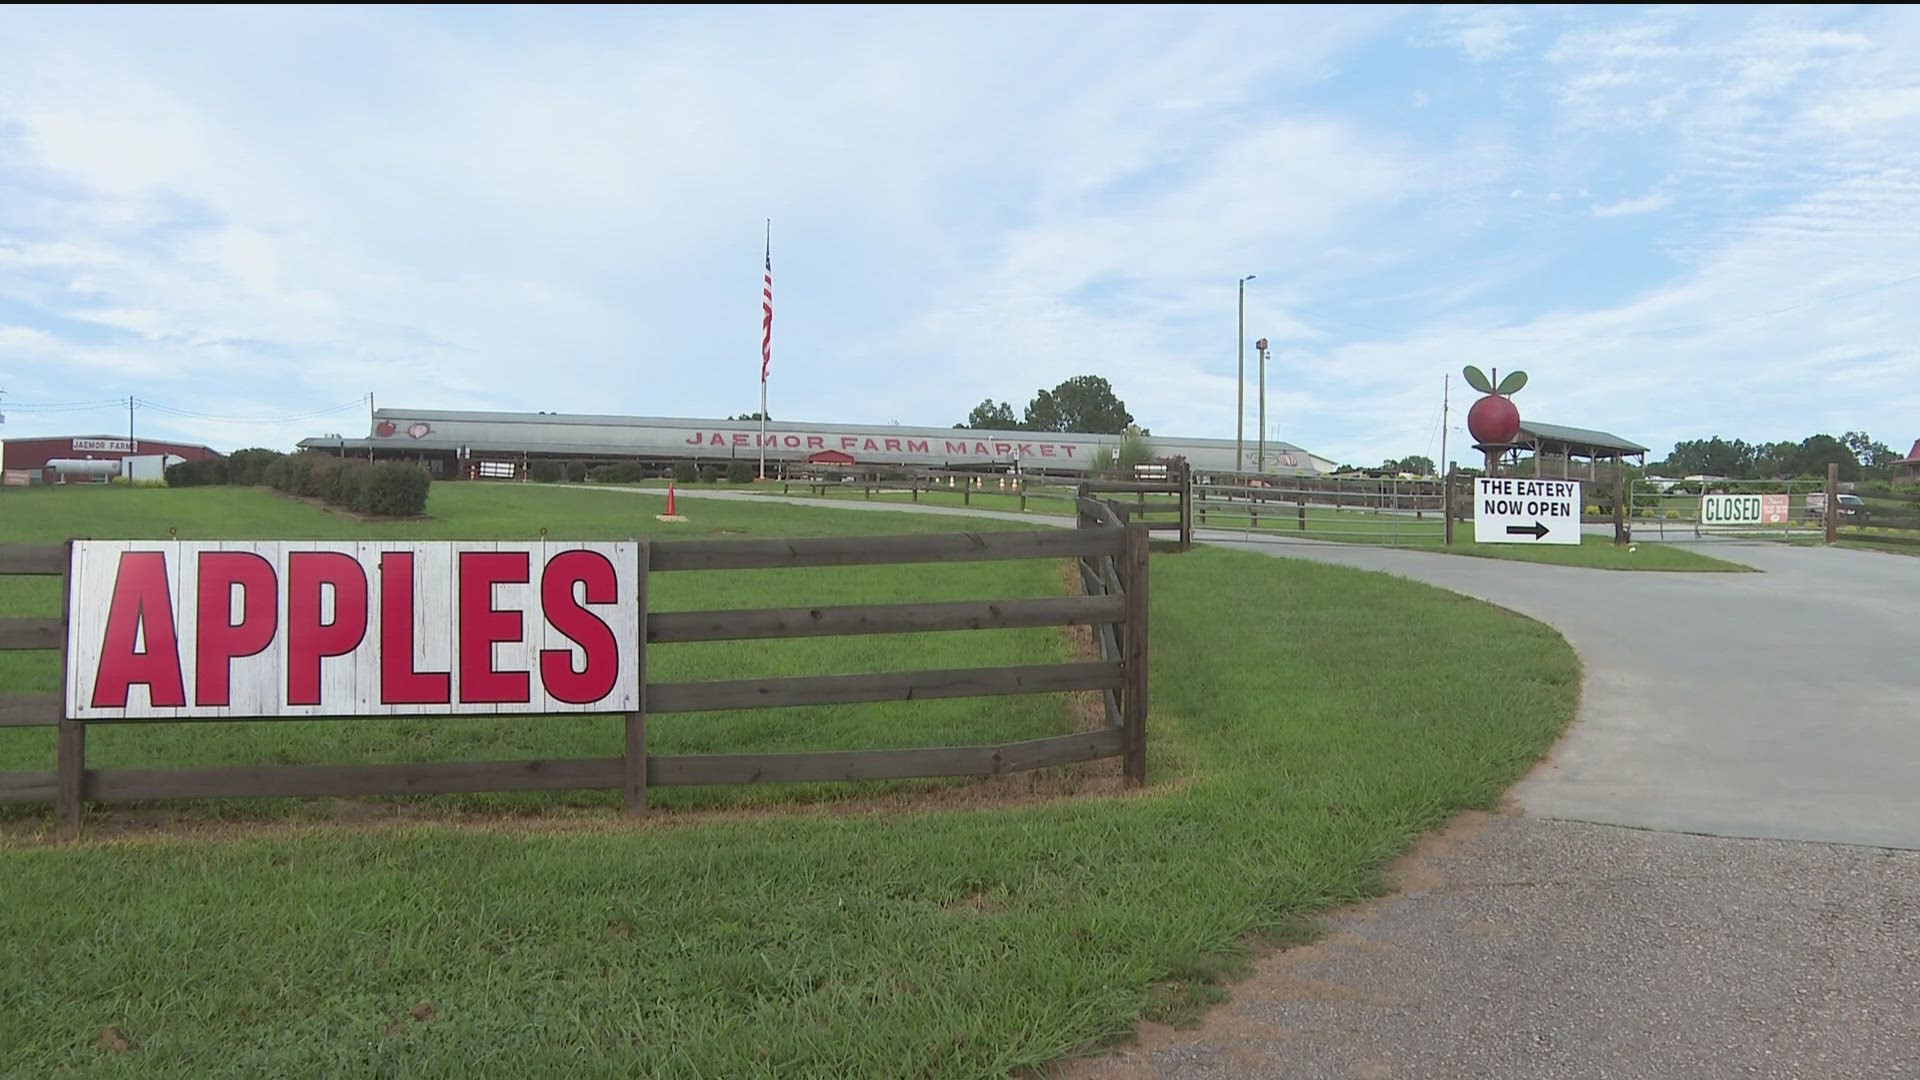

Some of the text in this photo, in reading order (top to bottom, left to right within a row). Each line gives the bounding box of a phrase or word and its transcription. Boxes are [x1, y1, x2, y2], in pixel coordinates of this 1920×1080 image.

[73, 441, 106, 449] JAEMOR
[686, 432, 1076, 458] JAEMOR FARM MARKET
[1481, 480, 1574, 497] THE EATERY
[1484, 500, 1570, 517] NOW OPEN
[1706, 498, 1760, 521] CLOSED
[91, 549, 619, 708] APPLES
